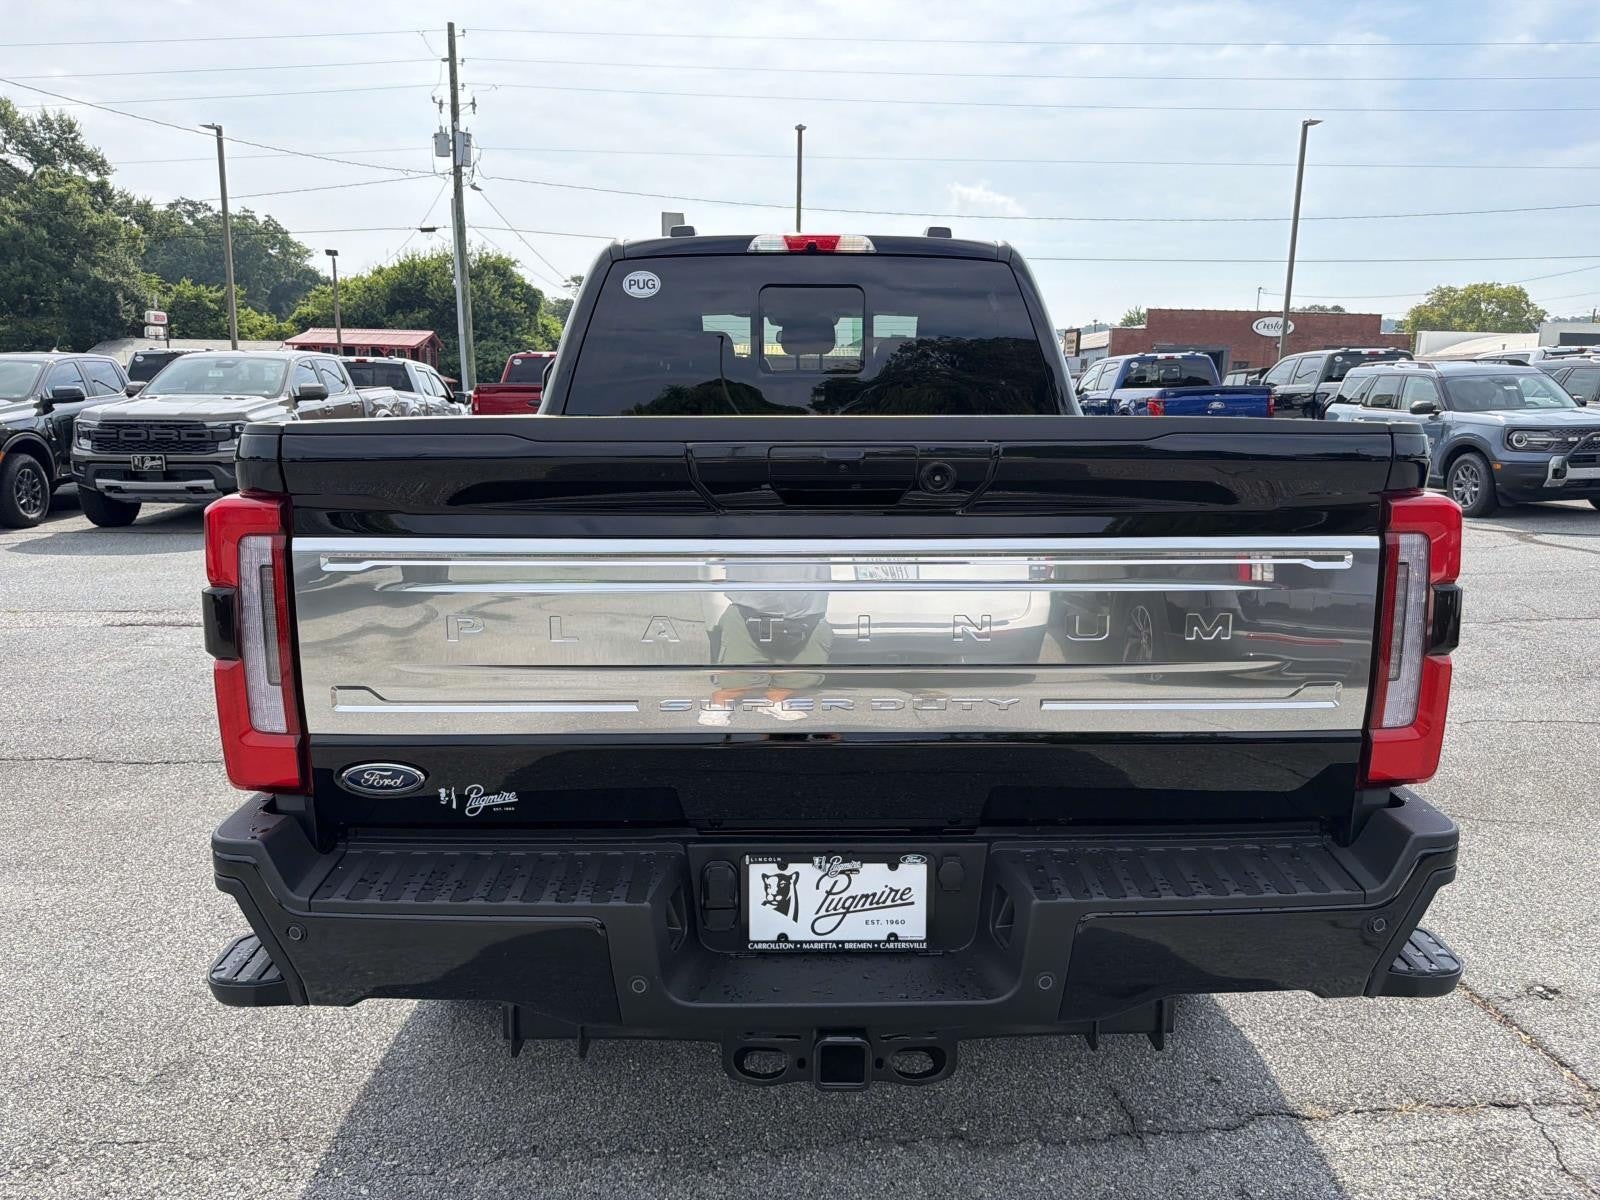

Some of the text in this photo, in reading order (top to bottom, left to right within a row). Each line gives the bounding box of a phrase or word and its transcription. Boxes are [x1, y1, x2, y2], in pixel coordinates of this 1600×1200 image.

[628, 278, 656, 290] PUG
[1255, 320, 1292, 331] Custo
[90, 429, 212, 441] FORD
[445, 612, 1233, 643] PLATINUM
[659, 698, 1021, 711] SUPER DUTY
[360, 769, 404, 788] Ford
[464, 783, 519, 817] Pugmire
[810, 871, 915, 936] Pugmire
[747, 942, 795, 950] CARROLLTON
